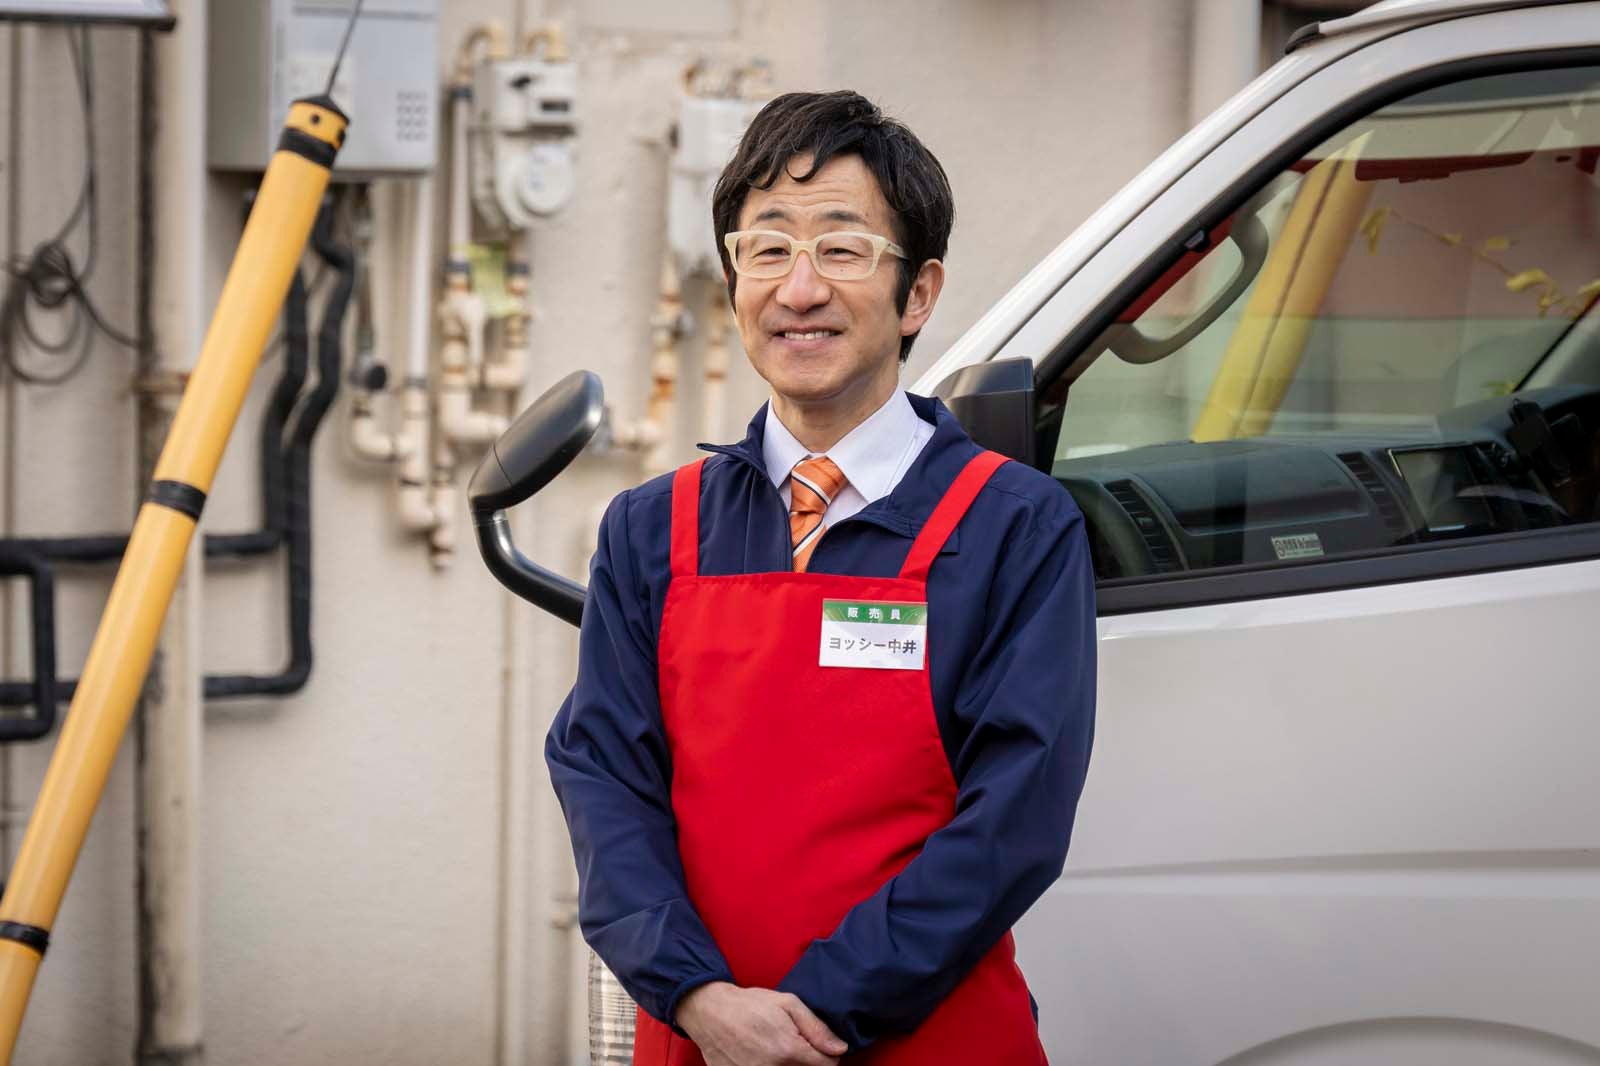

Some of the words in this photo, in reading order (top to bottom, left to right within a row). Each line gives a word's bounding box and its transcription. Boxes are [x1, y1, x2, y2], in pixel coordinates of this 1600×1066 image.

[847, 607, 901, 620] 販売員
[829, 637, 917, 654] ヨッシー中井
